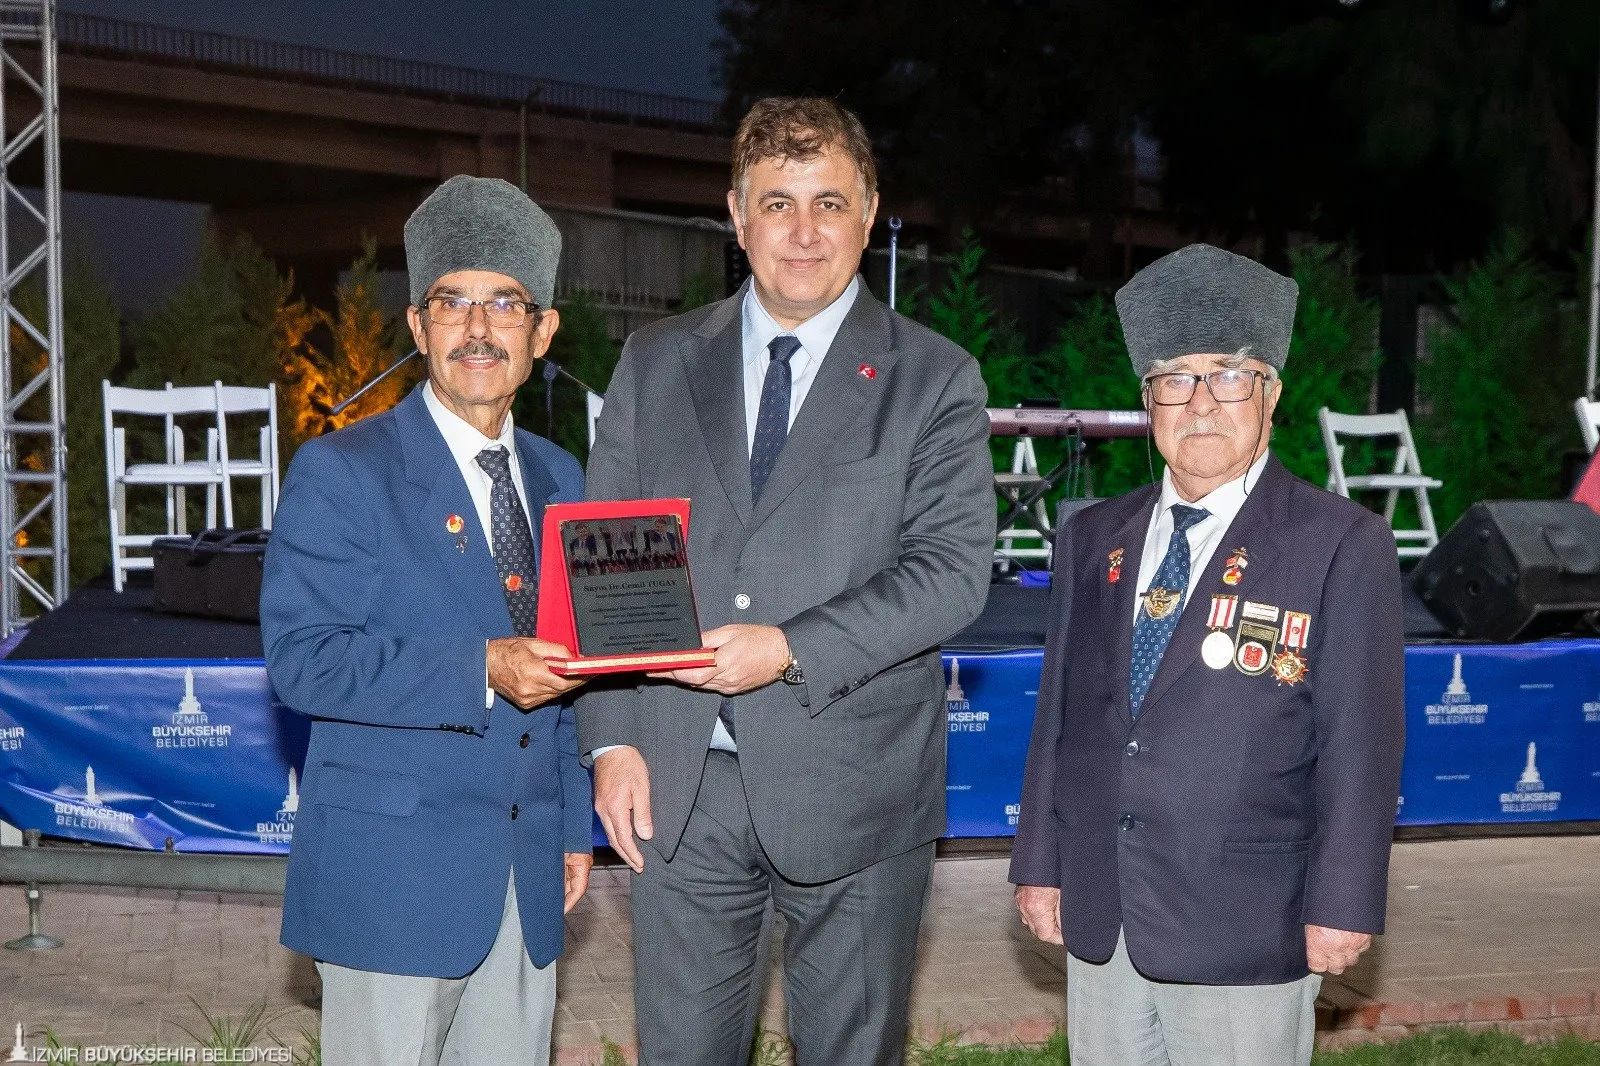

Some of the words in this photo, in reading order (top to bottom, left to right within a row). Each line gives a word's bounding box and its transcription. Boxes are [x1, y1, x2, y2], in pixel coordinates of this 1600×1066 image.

[172, 713, 208, 725] İZMİR
[152, 724, 232, 738] BÜYÜKŞEHİR
[156, 736, 228, 748] BELEDİYESİ
